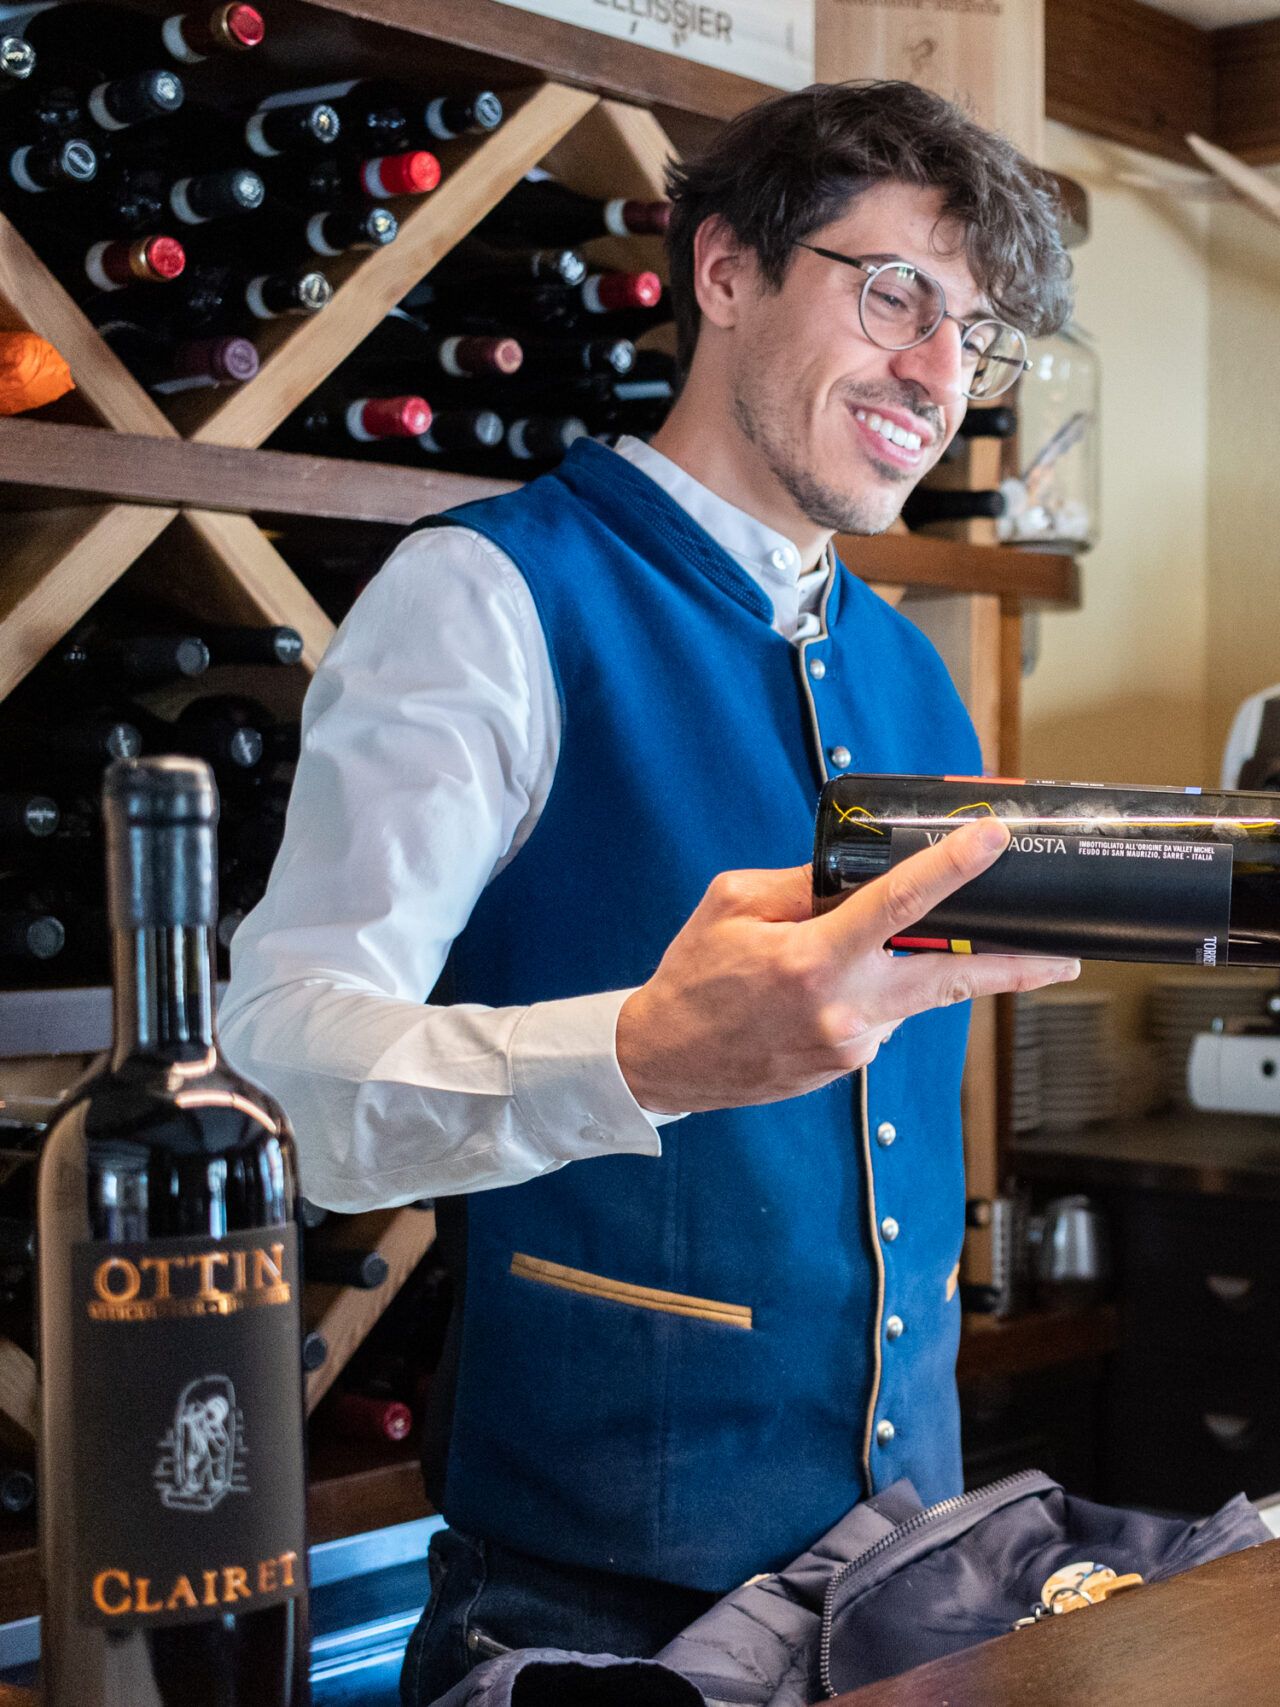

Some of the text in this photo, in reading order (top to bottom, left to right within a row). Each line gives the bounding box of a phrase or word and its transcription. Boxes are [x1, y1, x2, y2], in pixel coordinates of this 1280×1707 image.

[1078, 848, 1100, 856] FEUDO
[1126, 850, 1161, 859] MAURIZIO,
[1162, 852, 1185, 860] SARRE
[1191, 853, 1213, 861] ITALIA
[1079, 840, 1124, 850] IMBOTTIGLIATO
[1125, 843, 1162, 852] ALL'ORIGINE
[1173, 845, 1193, 853] VALLET
[94, 1243, 285, 1303] OTTIN
[92, 1551, 298, 1616] CLAIRET
